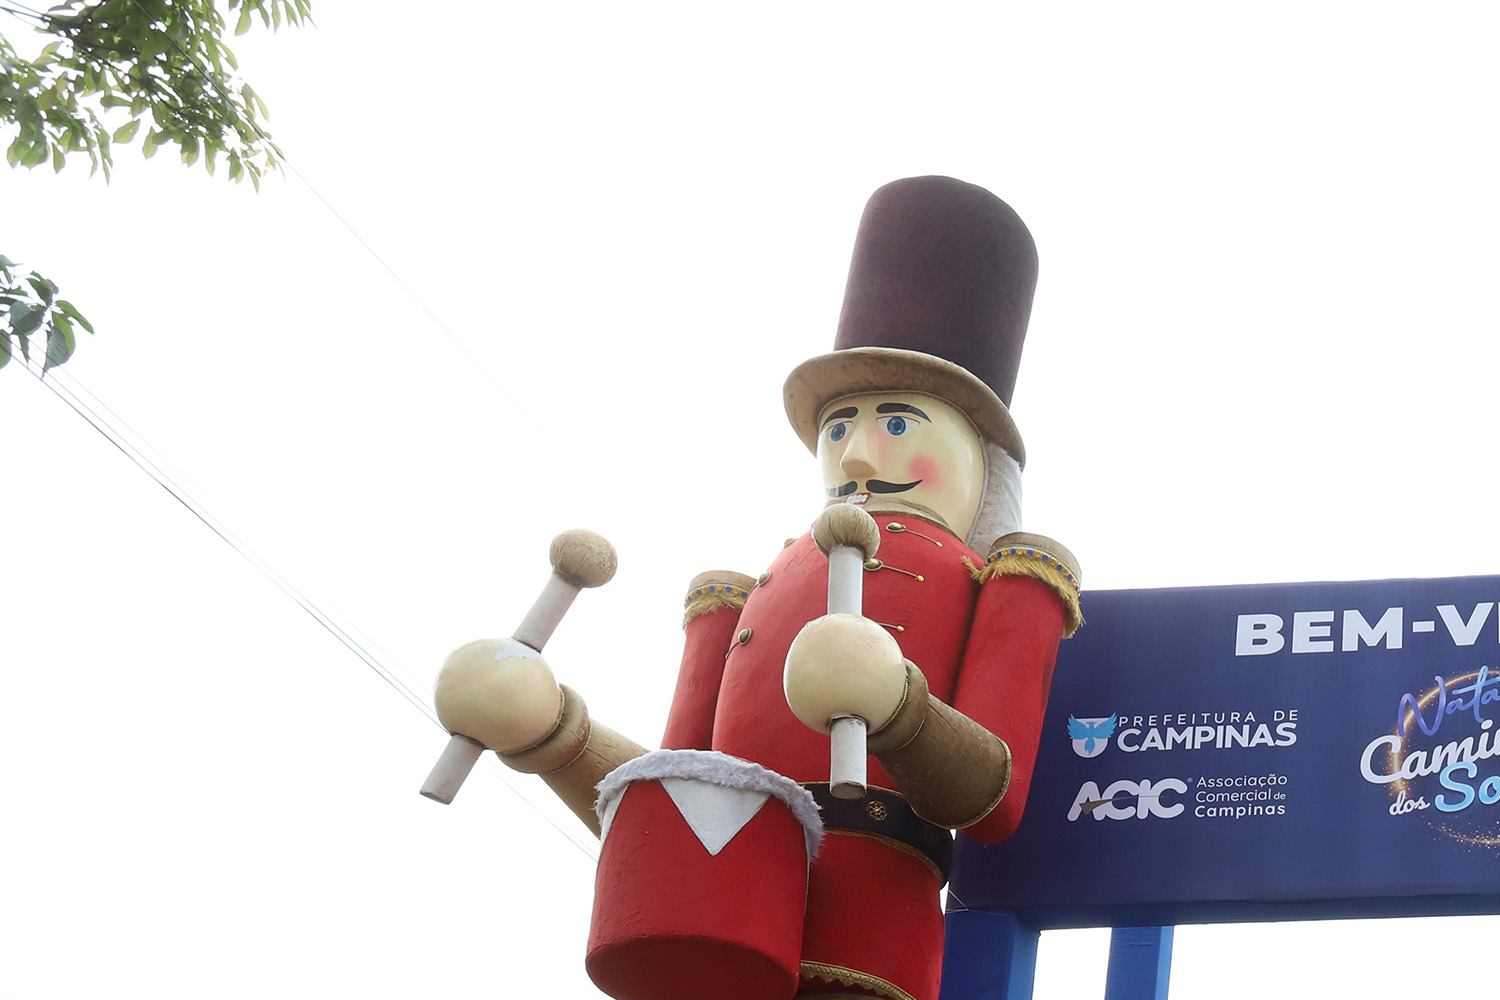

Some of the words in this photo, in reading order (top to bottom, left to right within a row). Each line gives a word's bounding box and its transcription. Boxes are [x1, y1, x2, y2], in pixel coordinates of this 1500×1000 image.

[1119, 711, 1256, 727] PREFEITURA
[1273, 709, 1299, 722] DE
[1117, 722, 1298, 752] CAMPINAS
[1196, 773, 1288, 788] Associação
[1067, 778, 1188, 822] ACIC
[1196, 788, 1271, 803] Comercial
[1273, 791, 1286, 801] de
[1389, 790, 1431, 815] dos
[1194, 804, 1286, 819] Campinas
